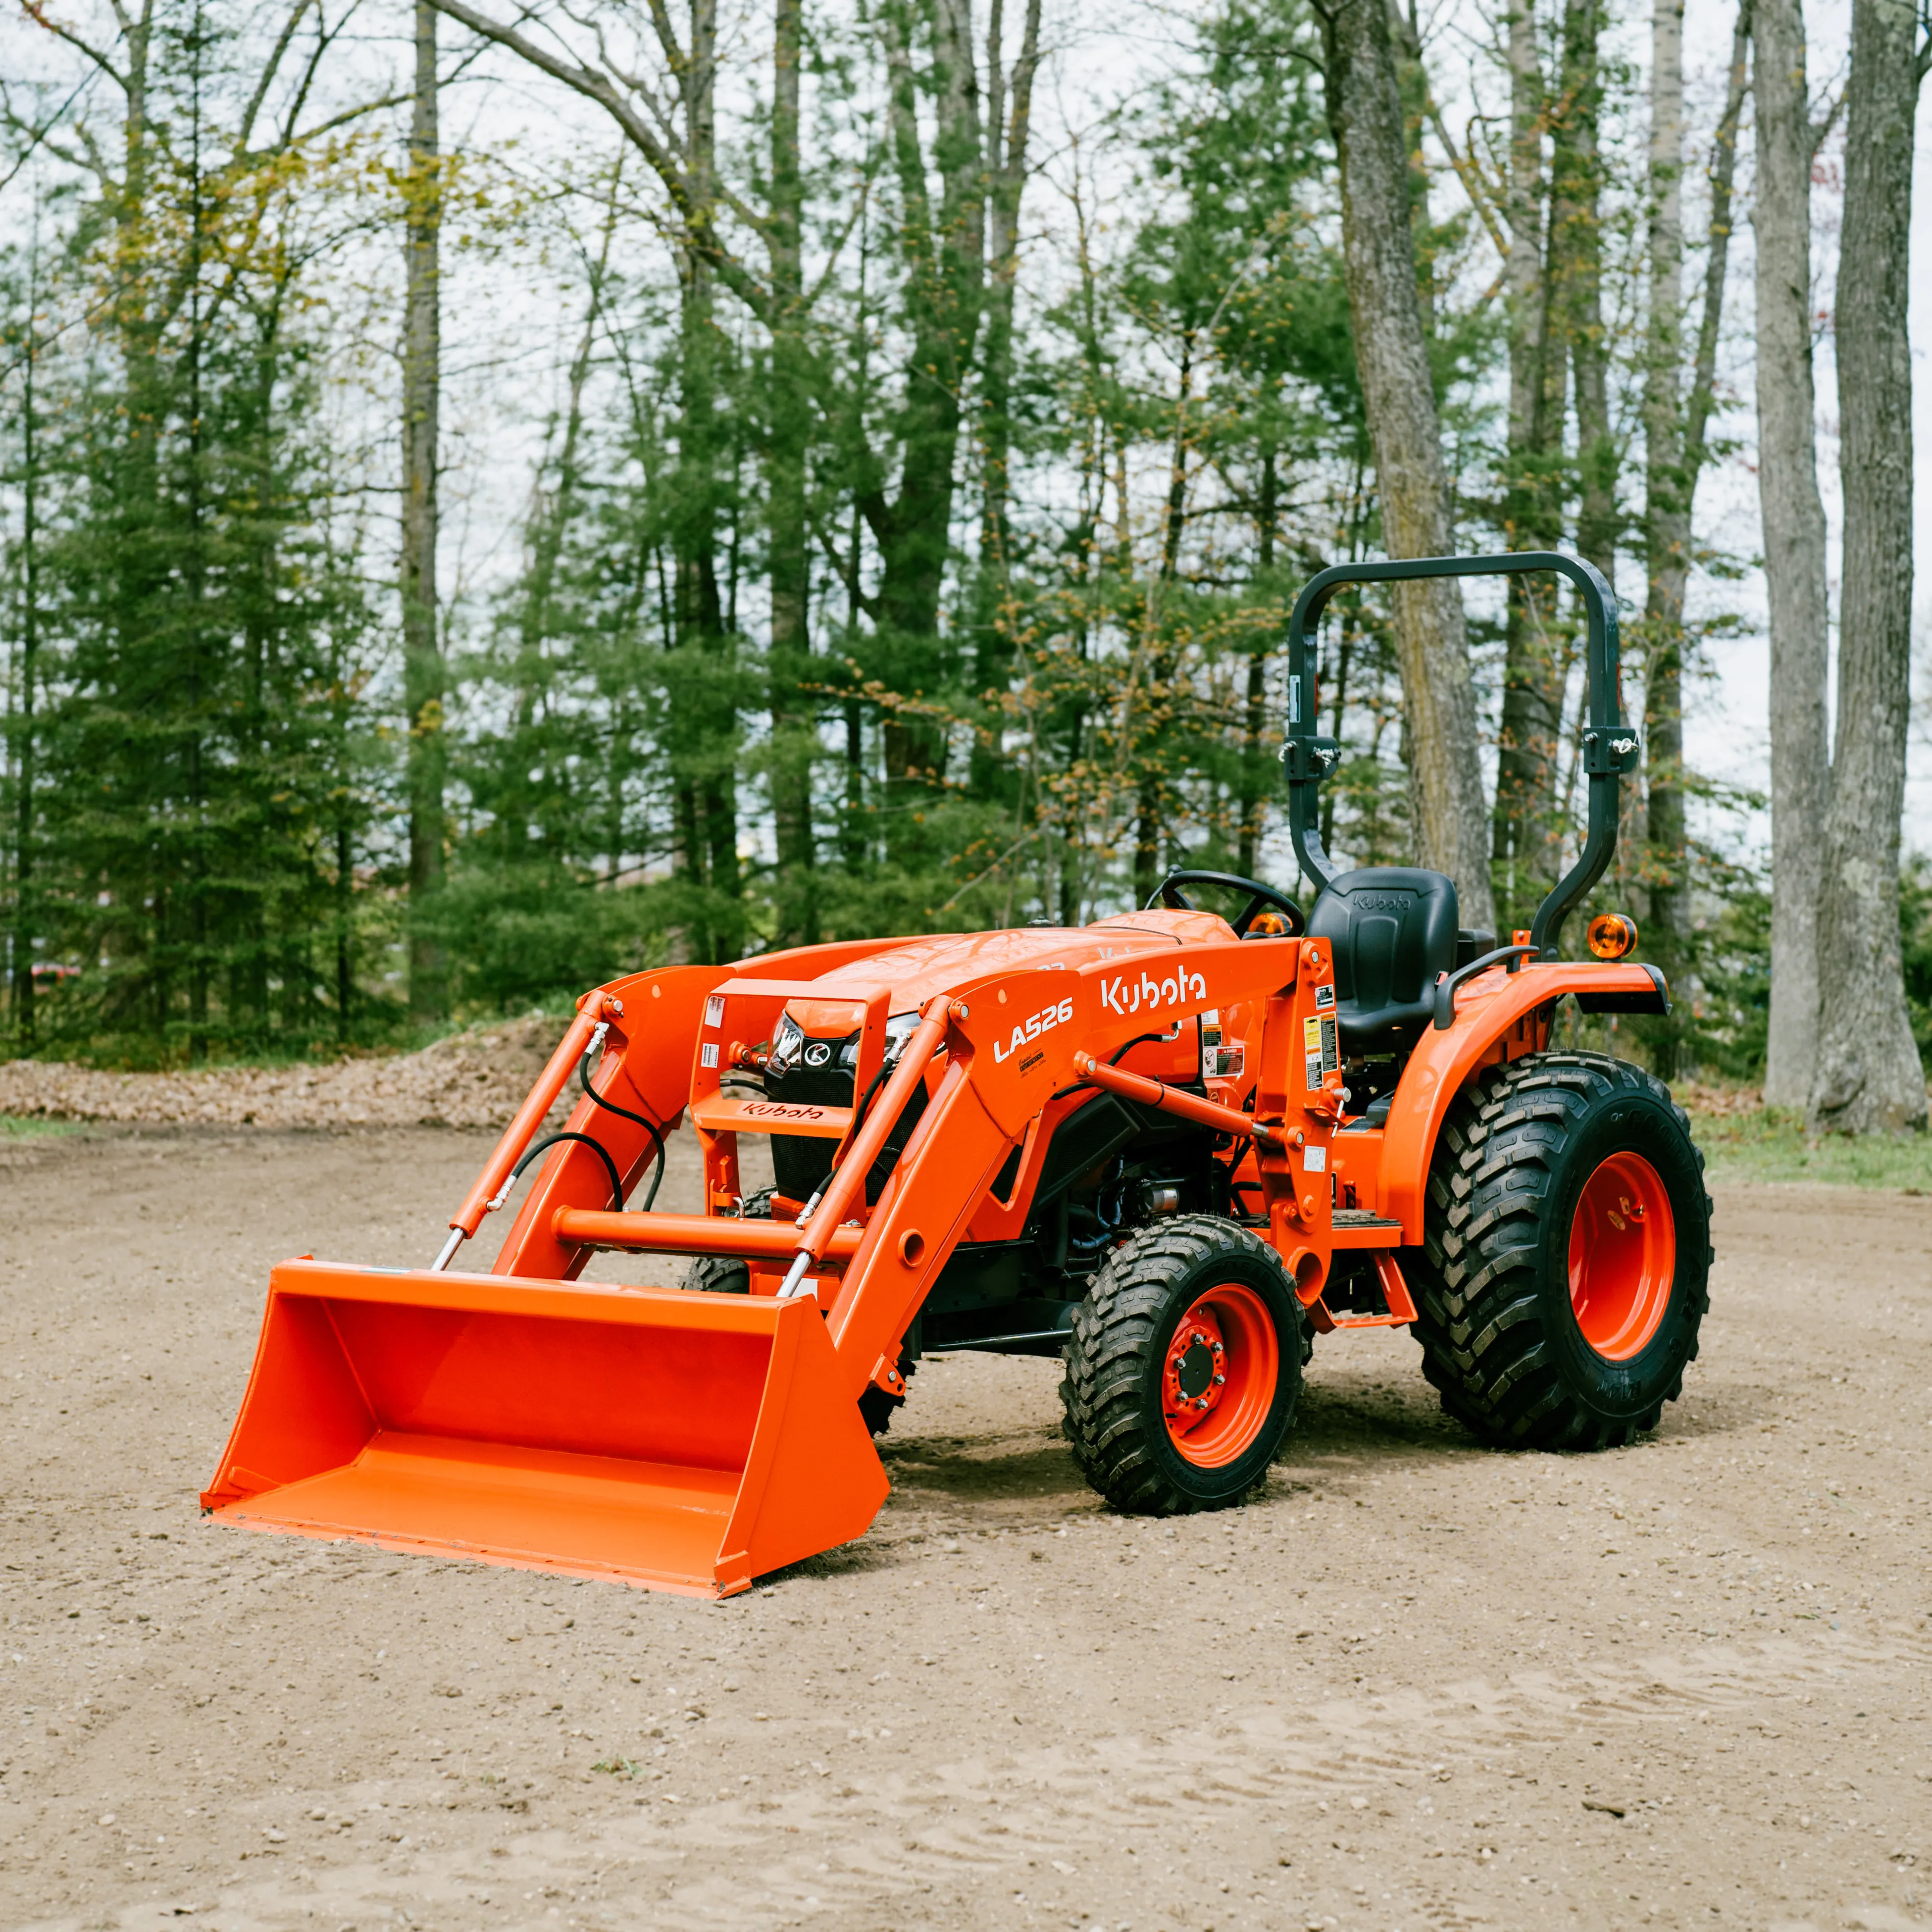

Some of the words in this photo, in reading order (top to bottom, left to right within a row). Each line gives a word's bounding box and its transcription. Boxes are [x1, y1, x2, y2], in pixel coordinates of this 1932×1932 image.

[1353, 895, 1411, 910] Kubota
[1101, 965, 1206, 1015] Kubota
[993, 997, 1073, 1064] LA526
[743, 1103, 824, 1119] Kubota
